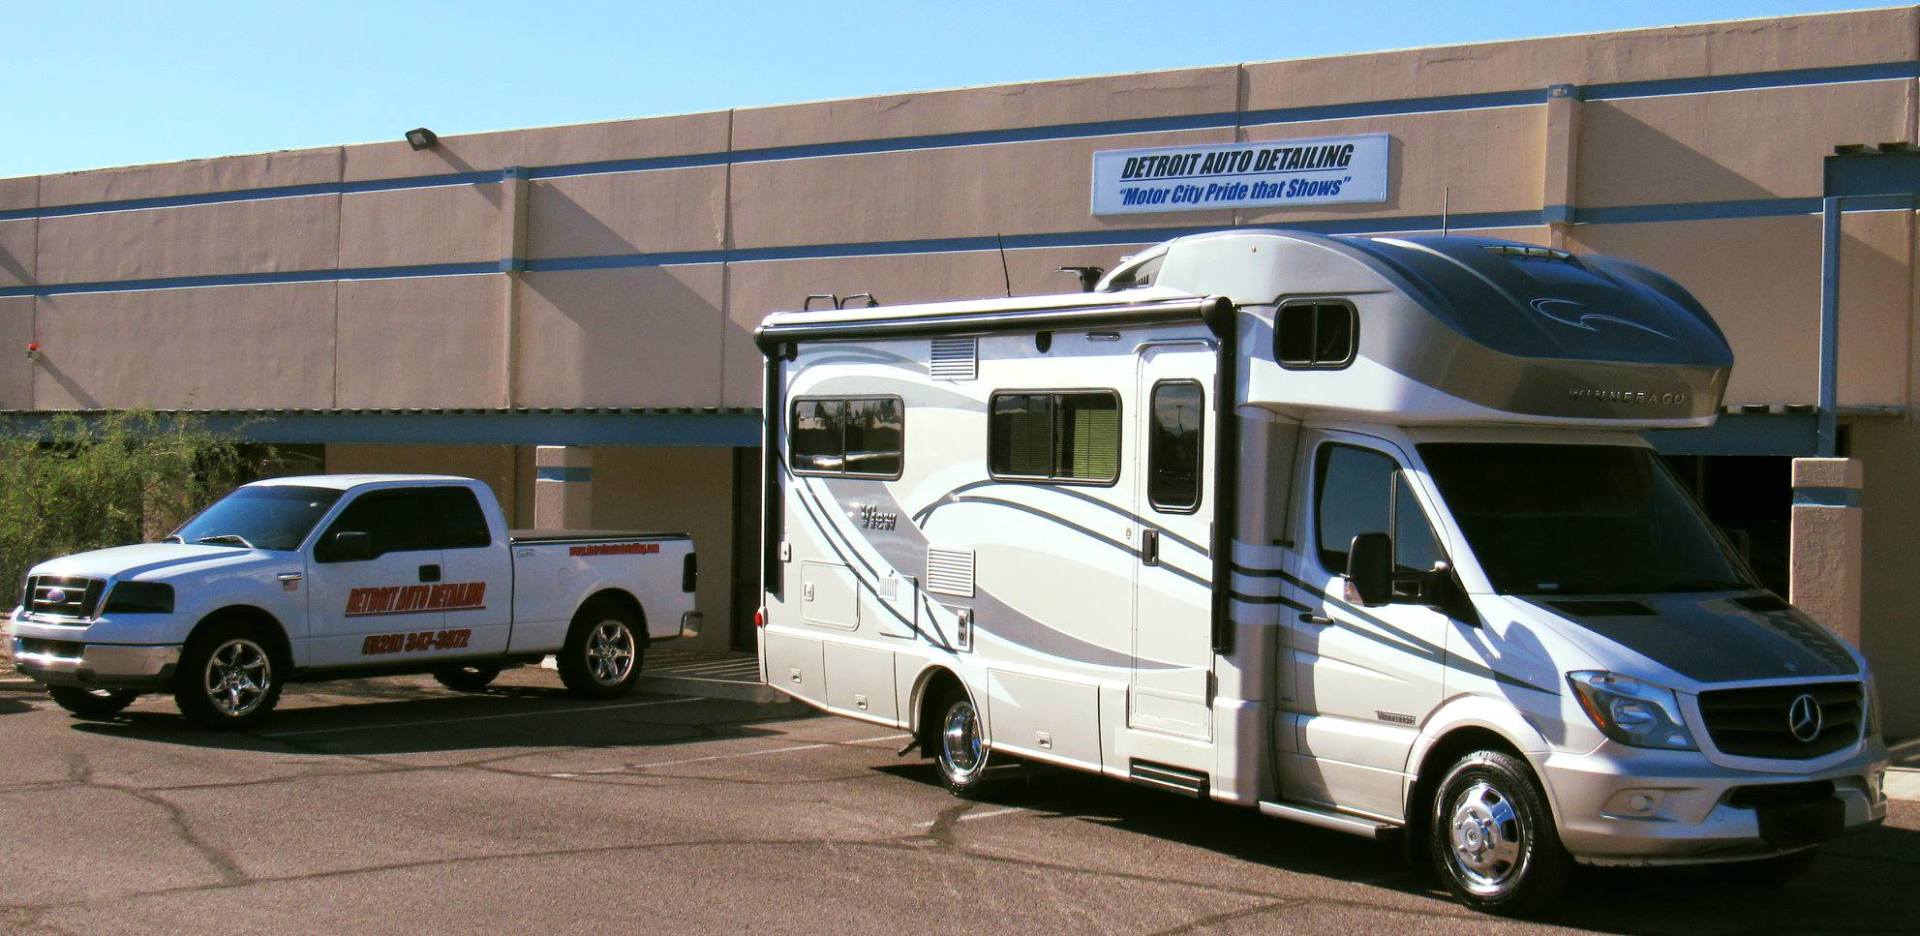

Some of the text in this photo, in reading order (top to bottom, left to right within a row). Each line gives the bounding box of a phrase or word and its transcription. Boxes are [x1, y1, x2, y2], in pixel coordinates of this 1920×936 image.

[1121, 143, 1354, 179] DETROIT AUTO DETAILING
[1171, 183, 1203, 204] City
[1206, 181, 1249, 201] Pride
[1250, 179, 1285, 199] that
[861, 504, 897, 531] View
[346, 581, 486, 613] DETROIT AUTO DETAILING
